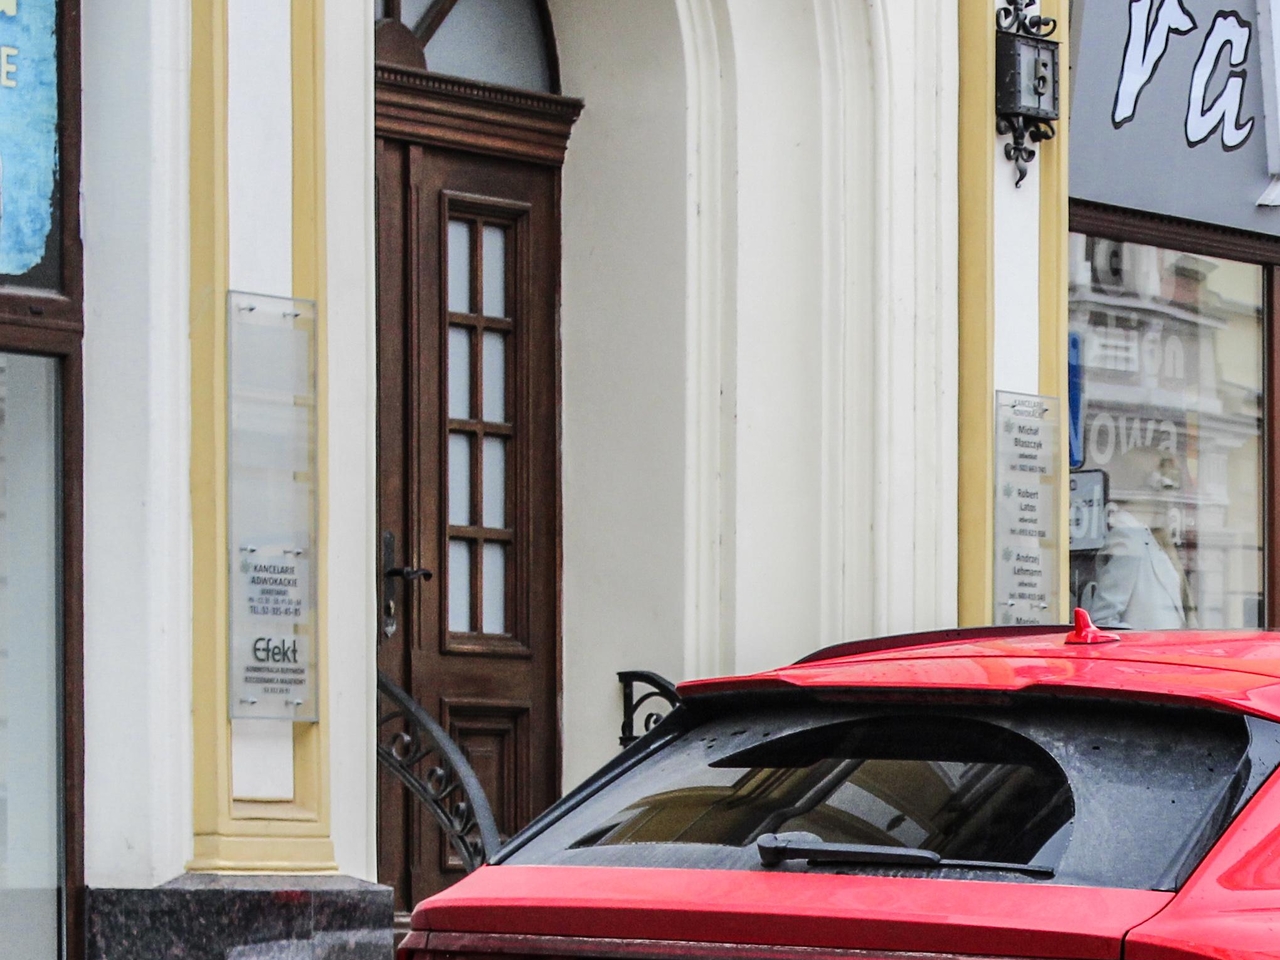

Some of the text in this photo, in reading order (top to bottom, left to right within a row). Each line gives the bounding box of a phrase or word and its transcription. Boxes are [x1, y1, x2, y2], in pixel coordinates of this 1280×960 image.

[1018, 489, 1039, 500] Robert
[253, 564, 295, 576] KANCELARIE
[251, 576, 298, 588] ADWOKACKIE
[253, 637, 298, 664] Efekt
